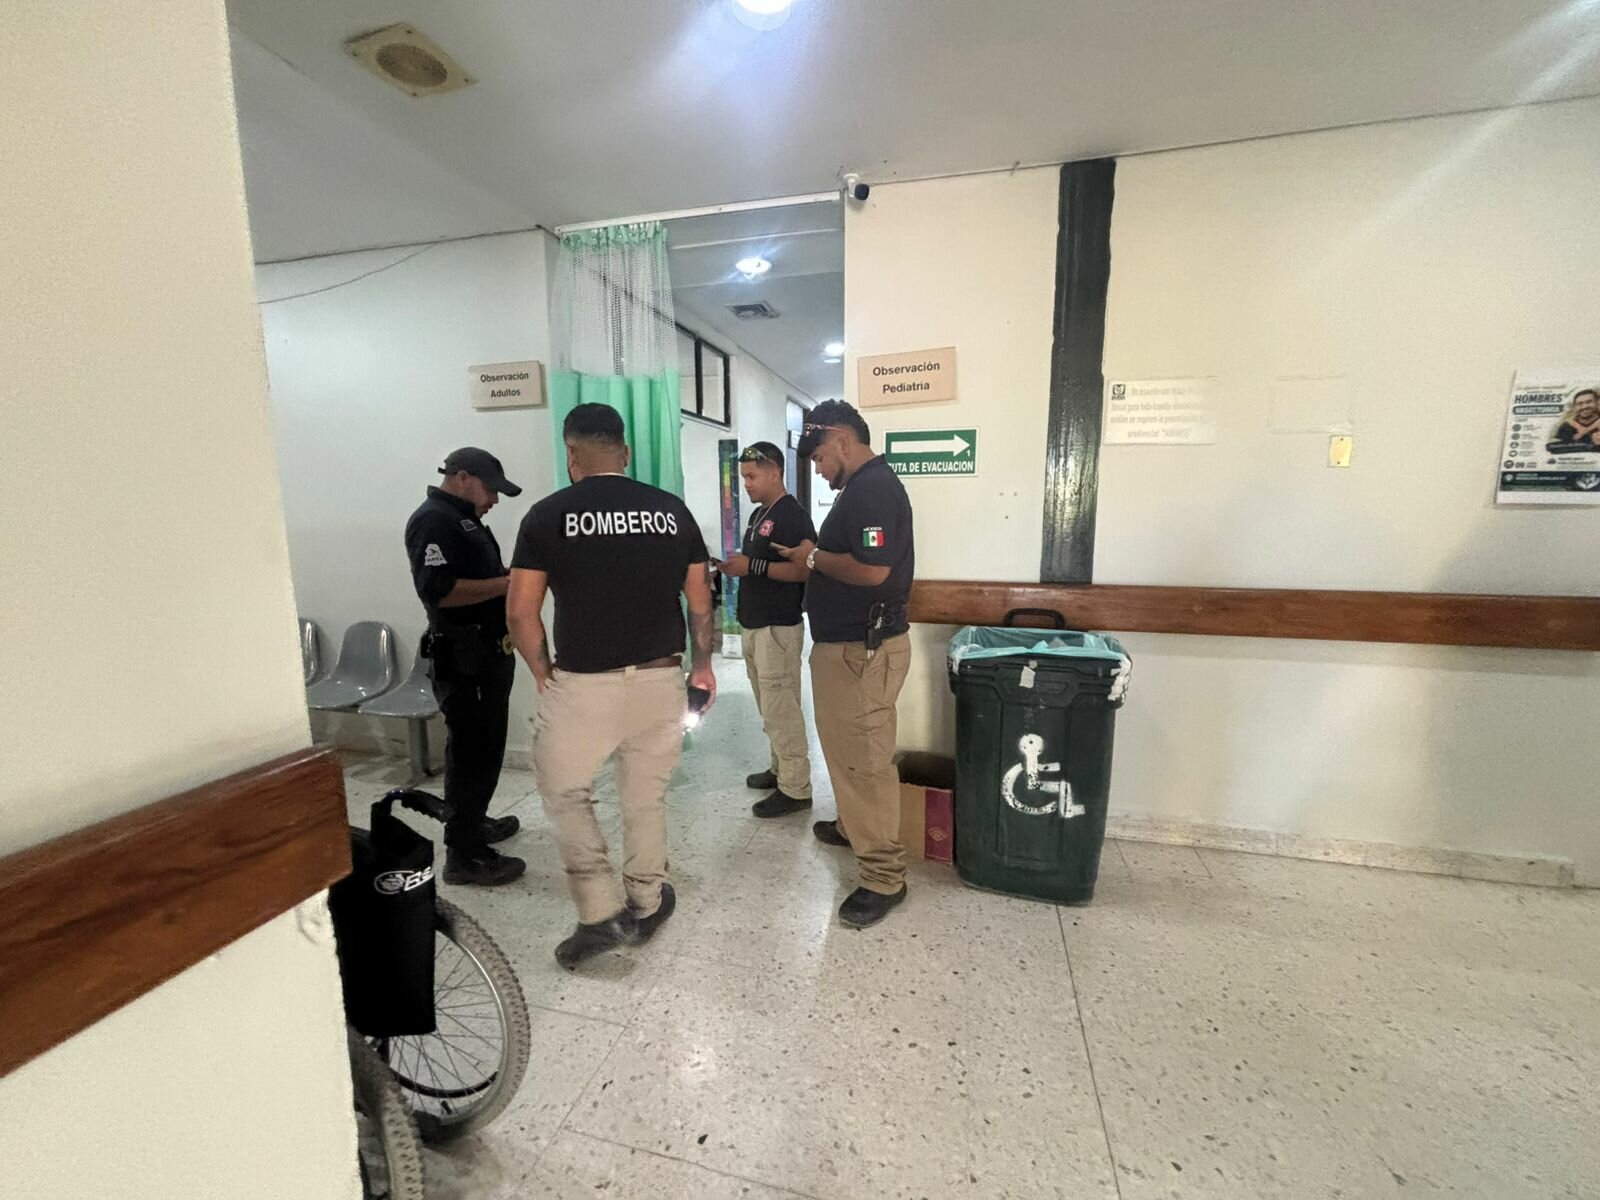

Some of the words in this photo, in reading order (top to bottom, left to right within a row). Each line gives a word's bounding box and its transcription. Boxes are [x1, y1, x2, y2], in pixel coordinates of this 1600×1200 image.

[872, 361, 940, 377] Observación
[480, 371, 530, 383] Observación
[490, 388, 521, 398] Adultos
[1514, 393, 1564, 404] HOMBRES
[909, 461, 920, 473] DE
[921, 460, 974, 473] EVACUACION
[565, 511, 678, 537] BOMBEROS
